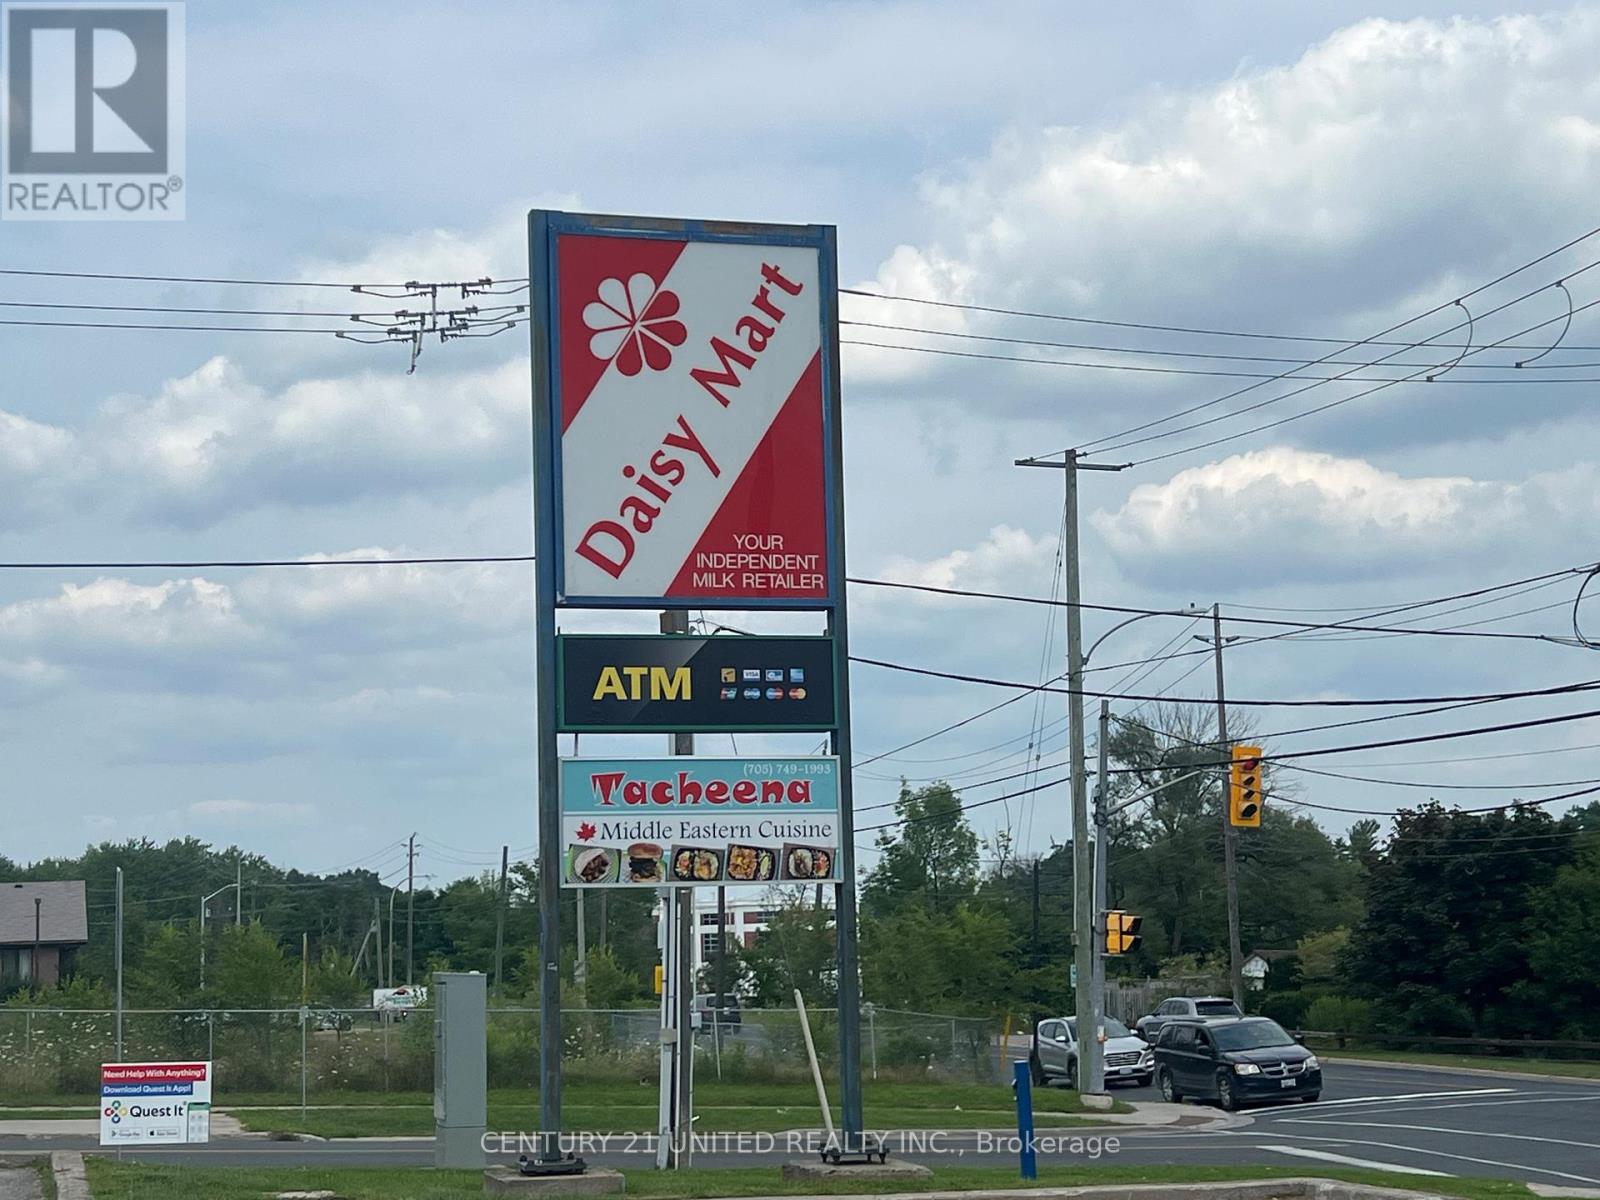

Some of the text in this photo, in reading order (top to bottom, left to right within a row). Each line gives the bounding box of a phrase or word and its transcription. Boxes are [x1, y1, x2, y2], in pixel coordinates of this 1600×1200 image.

[576, 261, 804, 579] Daisy Mart
[732, 534, 783, 550] YOUR
[696, 553, 819, 570] INDEPENDENT
[693, 572, 824, 589] MILK RETAILER
[592, 666, 692, 701] ATM
[743, 763, 831, 777] (705) 749-1993
[590, 770, 813, 807] Tacheena
[600, 819, 832, 841] Middle Eastern Cuisine
[103, 1068, 205, 1079] Need Help With Anything?
[103, 1085, 141, 1093] Download
[142, 1085, 165, 1093] Quest
[129, 1105, 184, 1118] Quest It
